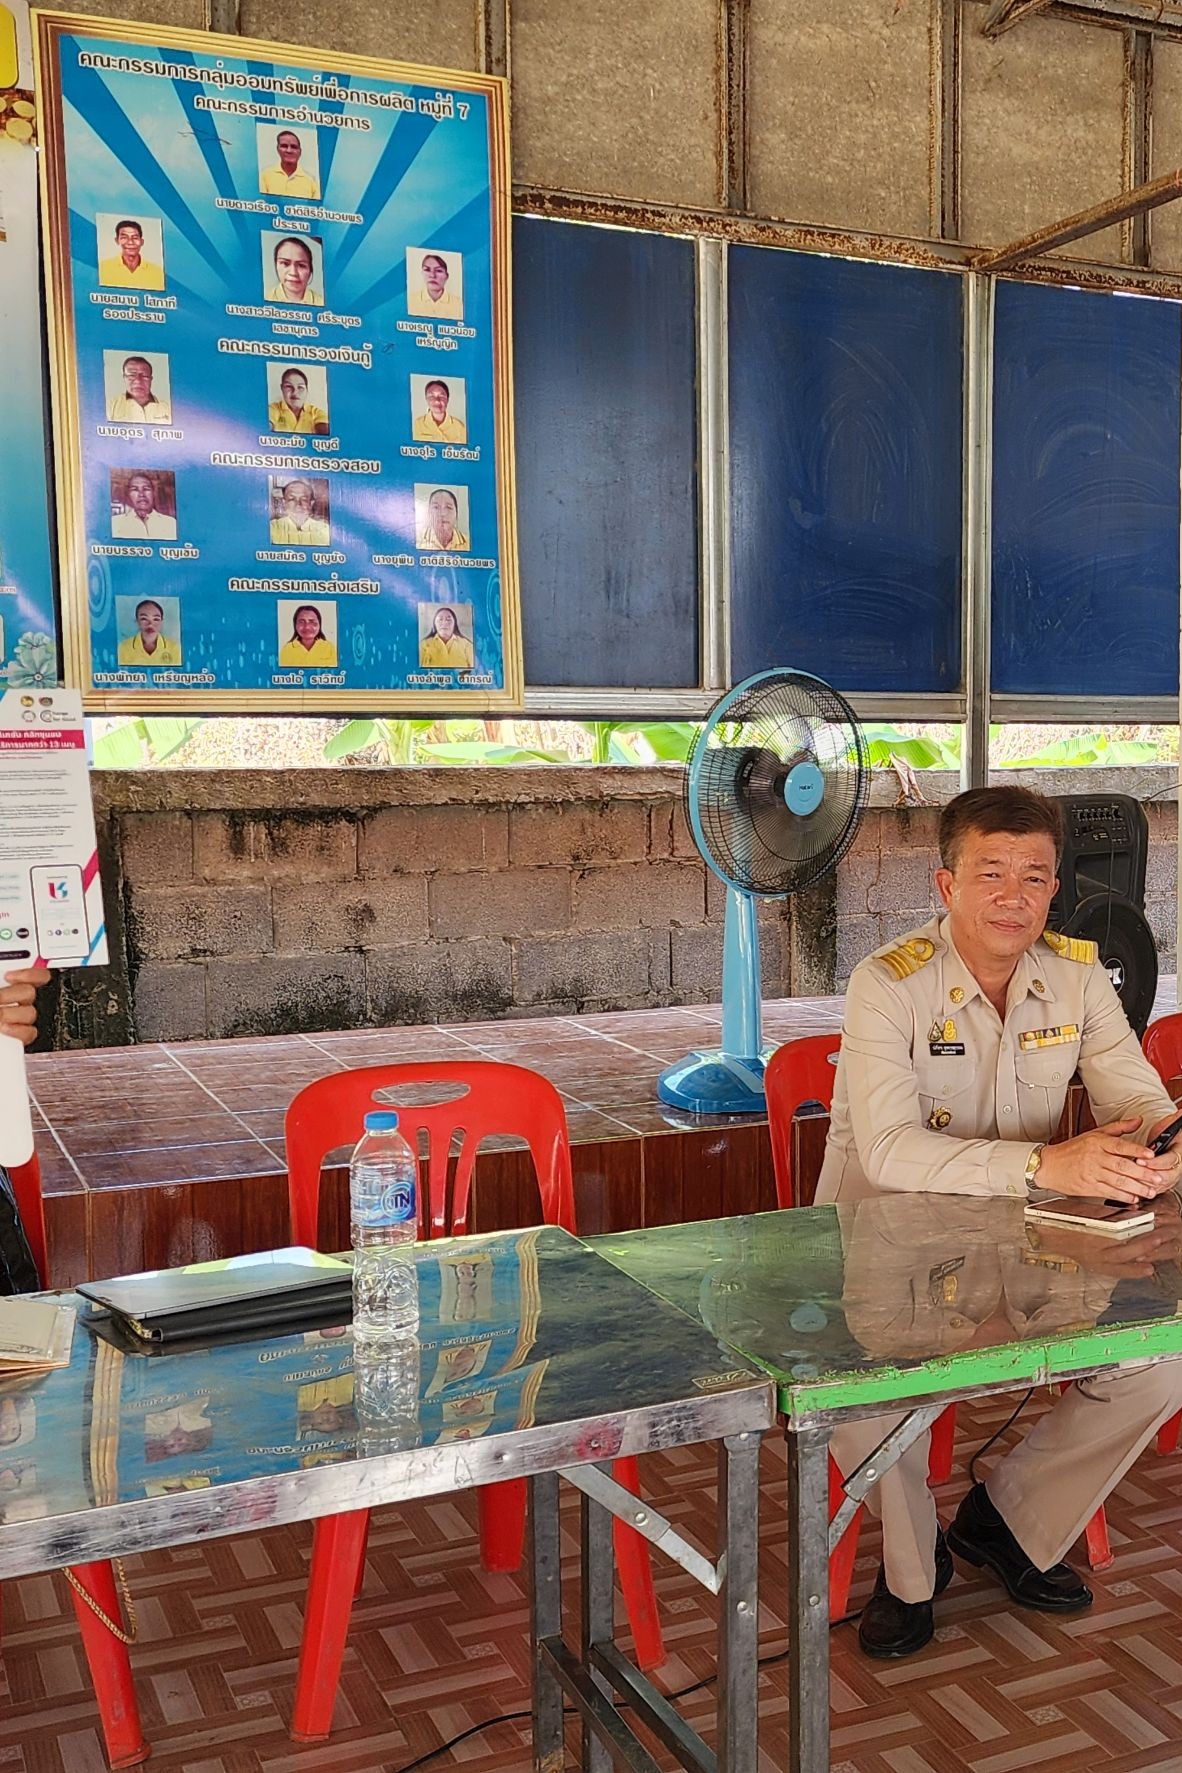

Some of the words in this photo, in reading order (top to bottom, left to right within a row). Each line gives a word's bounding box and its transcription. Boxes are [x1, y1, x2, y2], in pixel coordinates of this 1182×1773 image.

[79, 52, 414, 112] คณะกรรมการกลุ่มออมทรัพย์เพื่อการผลิต
[419, 92, 453, 121] หมู่ที่
[458, 104, 469, 119] 7
[194, 95, 371, 131] คณะกรรมการอำนวยการ
[273, 217, 310, 231] ประธาน
[103, 308, 166, 323] รองประธาน
[226, 303, 312, 322] นางสาววิไลวรรณ
[272, 322, 319, 338] เลขานุการ
[218, 338, 373, 368] คณะกรรมการวงเงินกู้
[210, 452, 381, 474] คณะกรรมการตรวจสอบ
[228, 572, 381, 594] คณะกรรมการส่งเสริม
